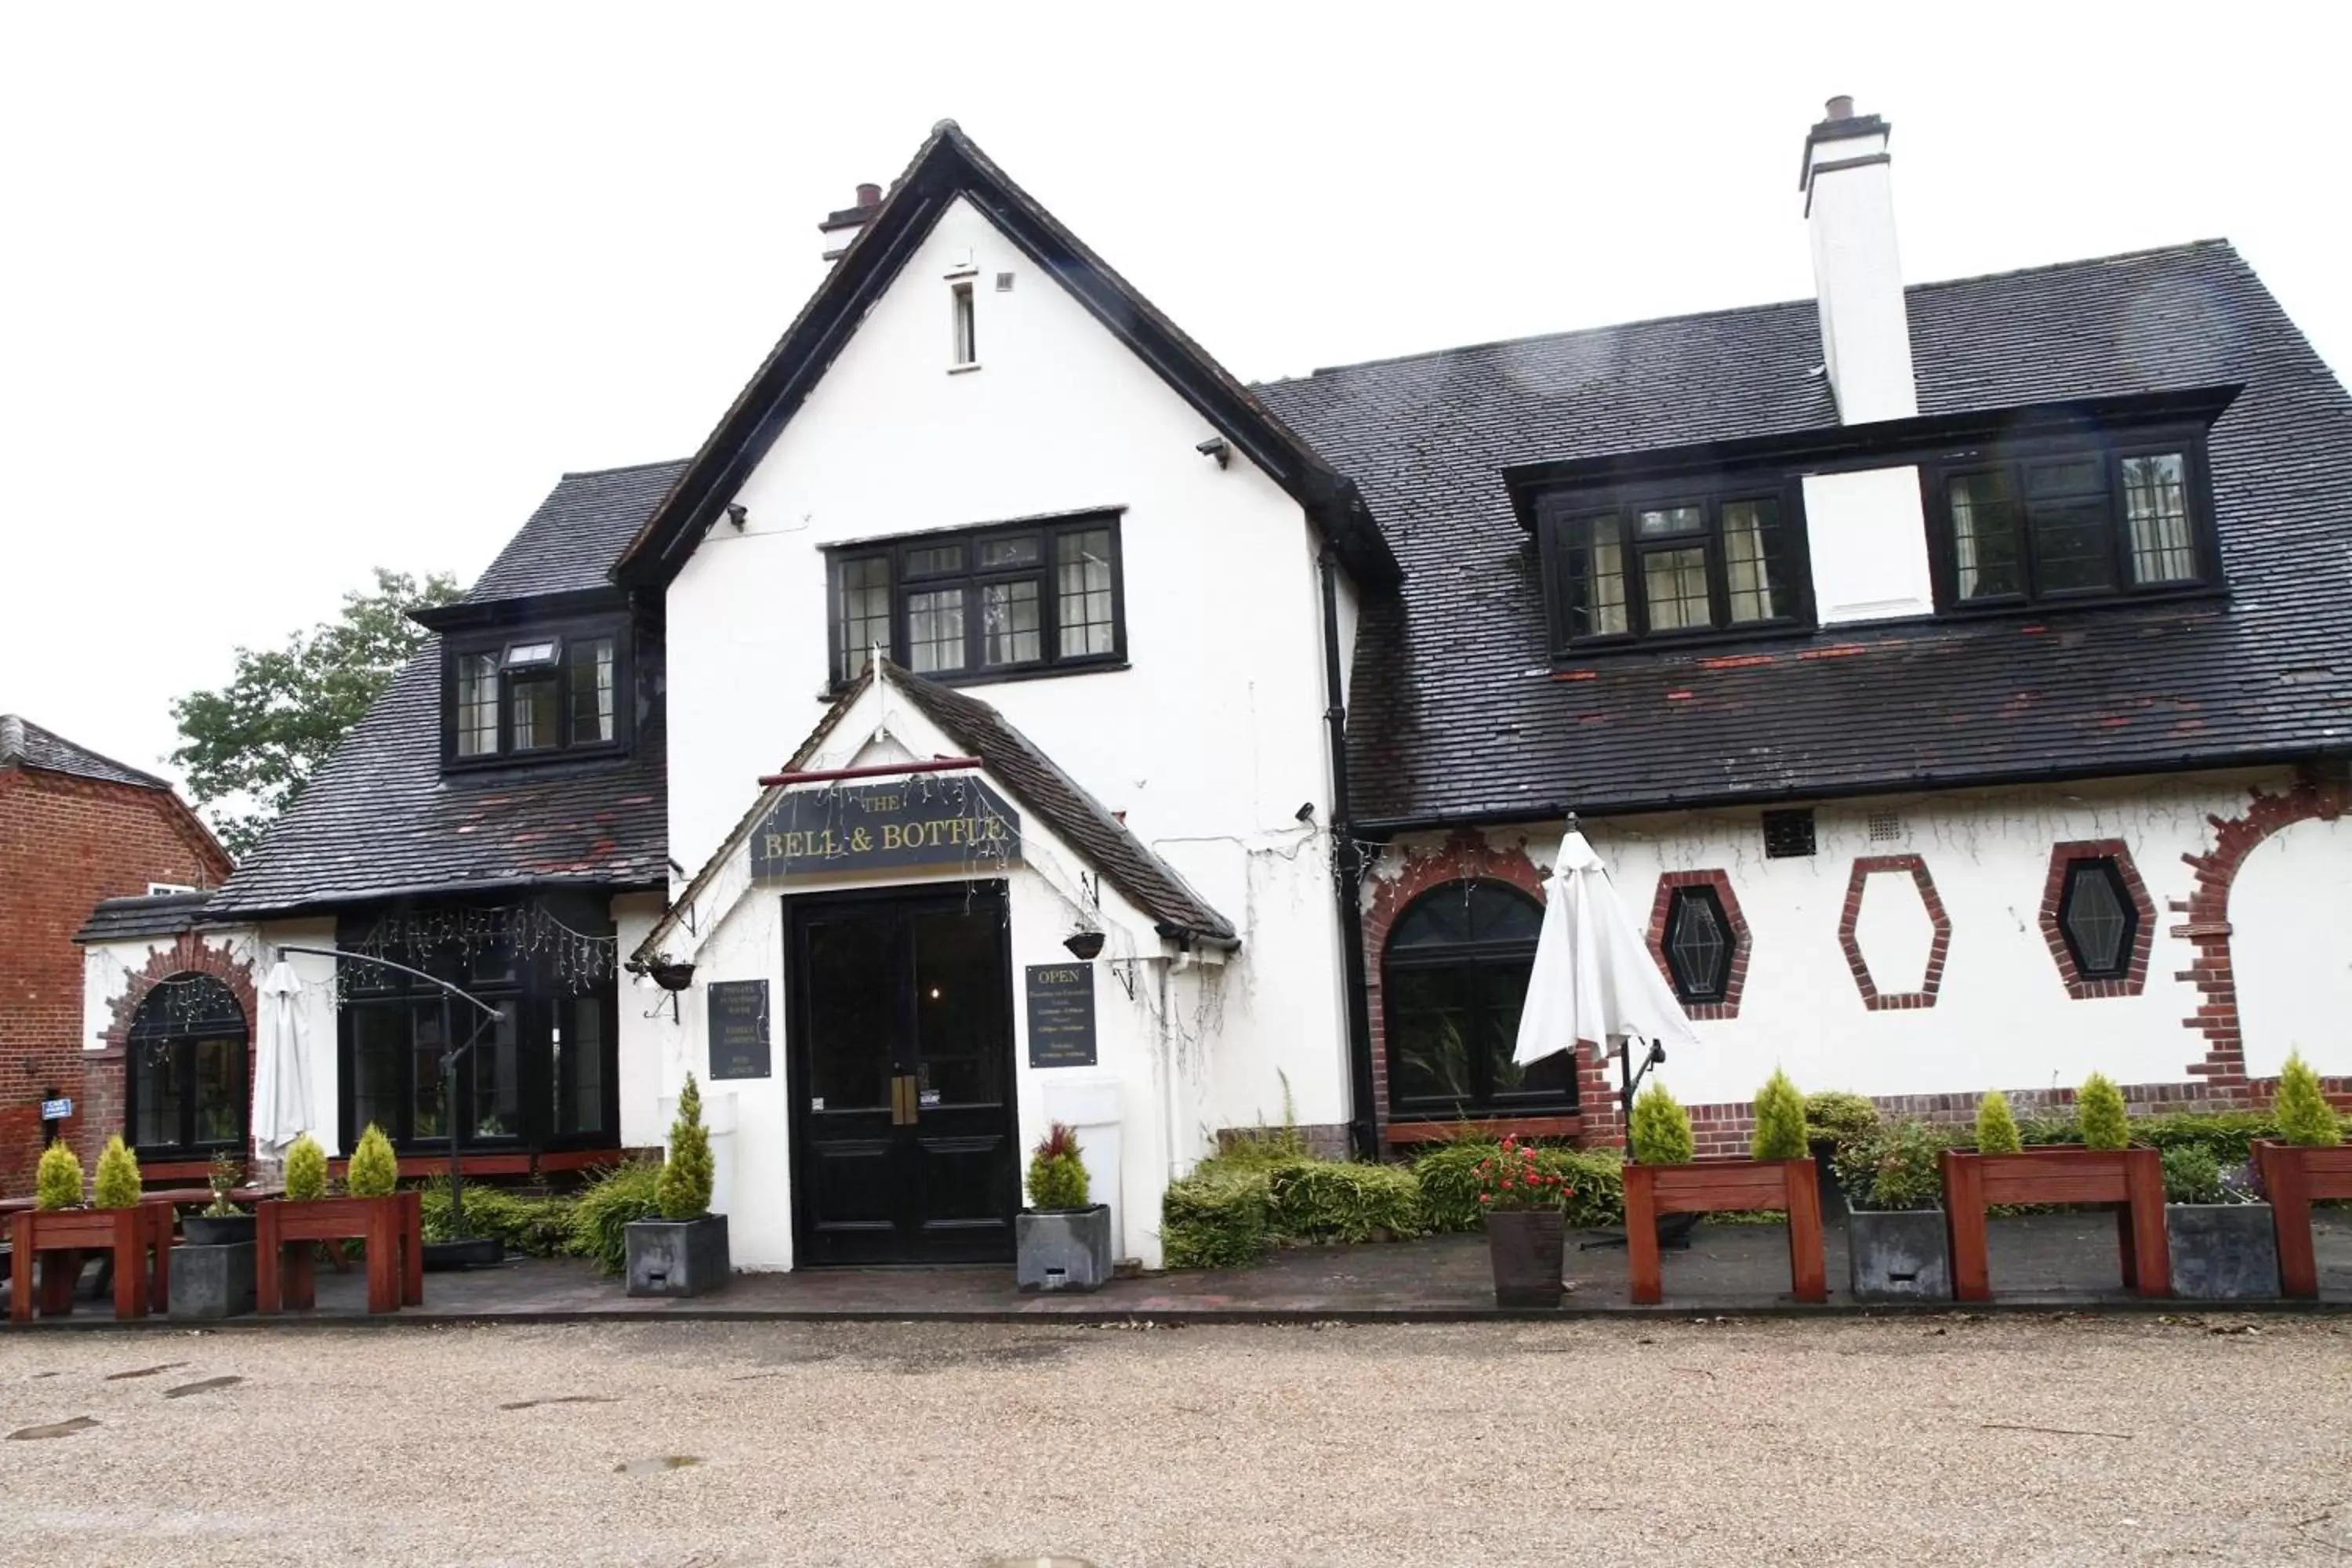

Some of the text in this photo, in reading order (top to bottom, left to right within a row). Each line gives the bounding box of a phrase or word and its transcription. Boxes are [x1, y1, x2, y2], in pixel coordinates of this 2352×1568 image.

[863, 795, 900, 813] THE
[764, 815, 1008, 858] BELL & BOTTLE
[1038, 969, 1080, 984] OPEN
